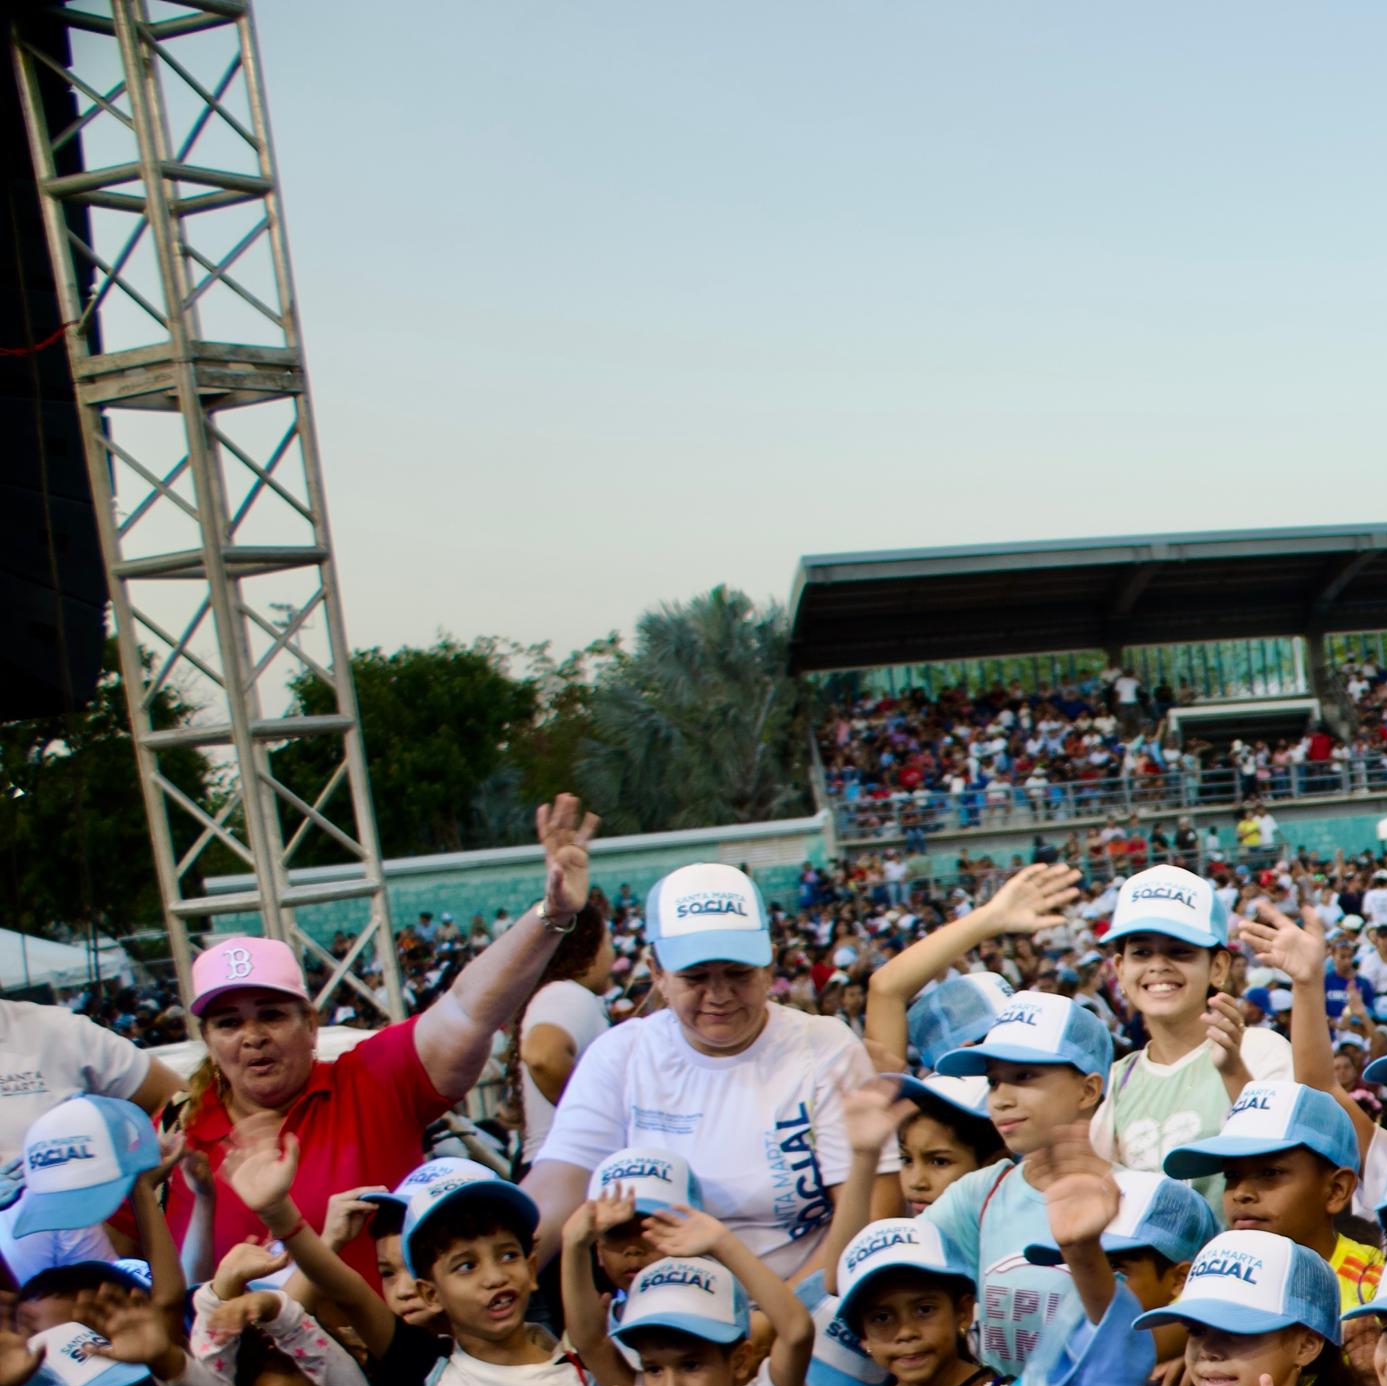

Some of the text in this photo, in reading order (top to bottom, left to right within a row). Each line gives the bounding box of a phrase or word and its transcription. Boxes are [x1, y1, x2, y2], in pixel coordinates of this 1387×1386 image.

[677, 899, 748, 918] SOCIAL
[1132, 888, 1196, 910] SOCIAL
[223, 947, 254, 981] B
[994, 1010, 1037, 1026] CIAL
[1229, 1097, 1271, 1117] CIAL
[28, 1144, 95, 1168] SOCIAL
[601, 1163, 672, 1186] SOCIAL
[847, 1233, 920, 1272] SOCIAL
[1220, 1248, 1263, 1269] MARTA
[640, 1271, 716, 1295] SOCIAL
[1189, 1258, 1258, 1285] SOCIAL
